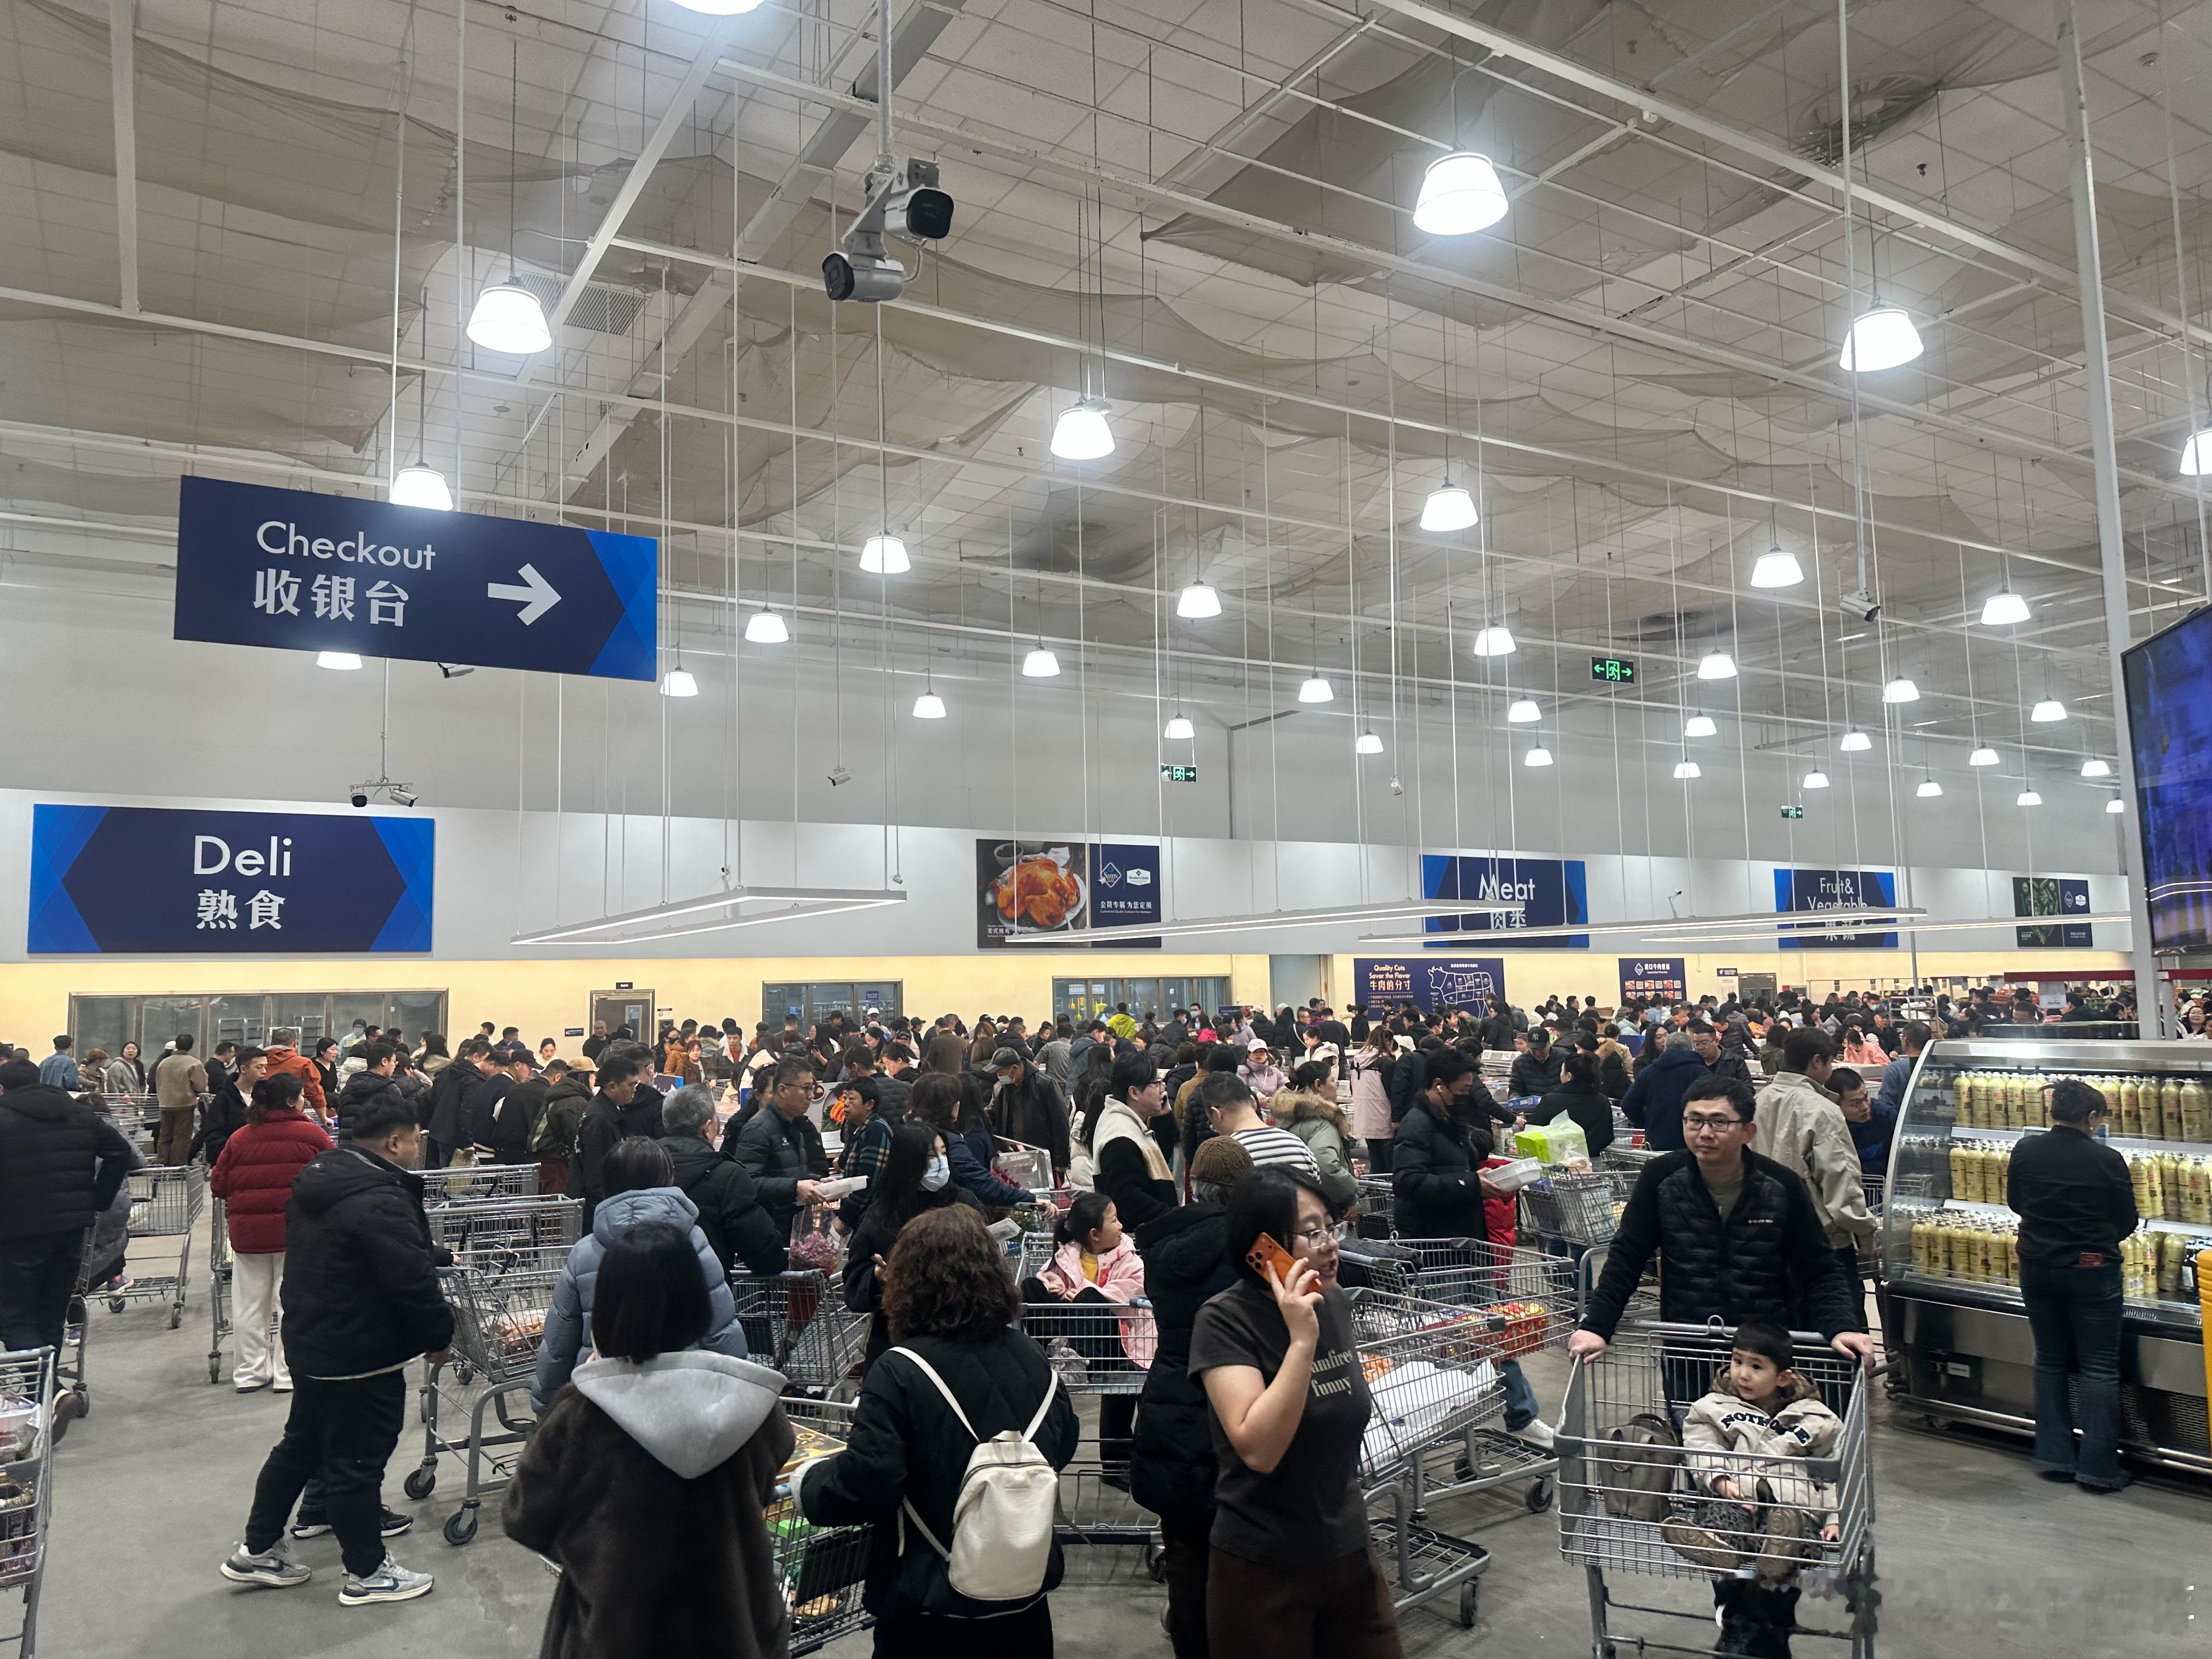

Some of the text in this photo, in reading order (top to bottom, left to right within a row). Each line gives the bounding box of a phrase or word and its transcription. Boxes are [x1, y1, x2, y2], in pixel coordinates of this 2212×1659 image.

[256, 521, 436, 571] Checkout
[253, 568, 409, 627] 收银台
[194, 835, 292, 877] Deli
[1479, 873, 1535, 900] Meat
[196, 889, 286, 930] 熟食
[1369, 980, 1410, 991] 牛肉的分寸
[1374, 964, 1393, 973] Quality
[1311, 1376, 1352, 1397] funny
